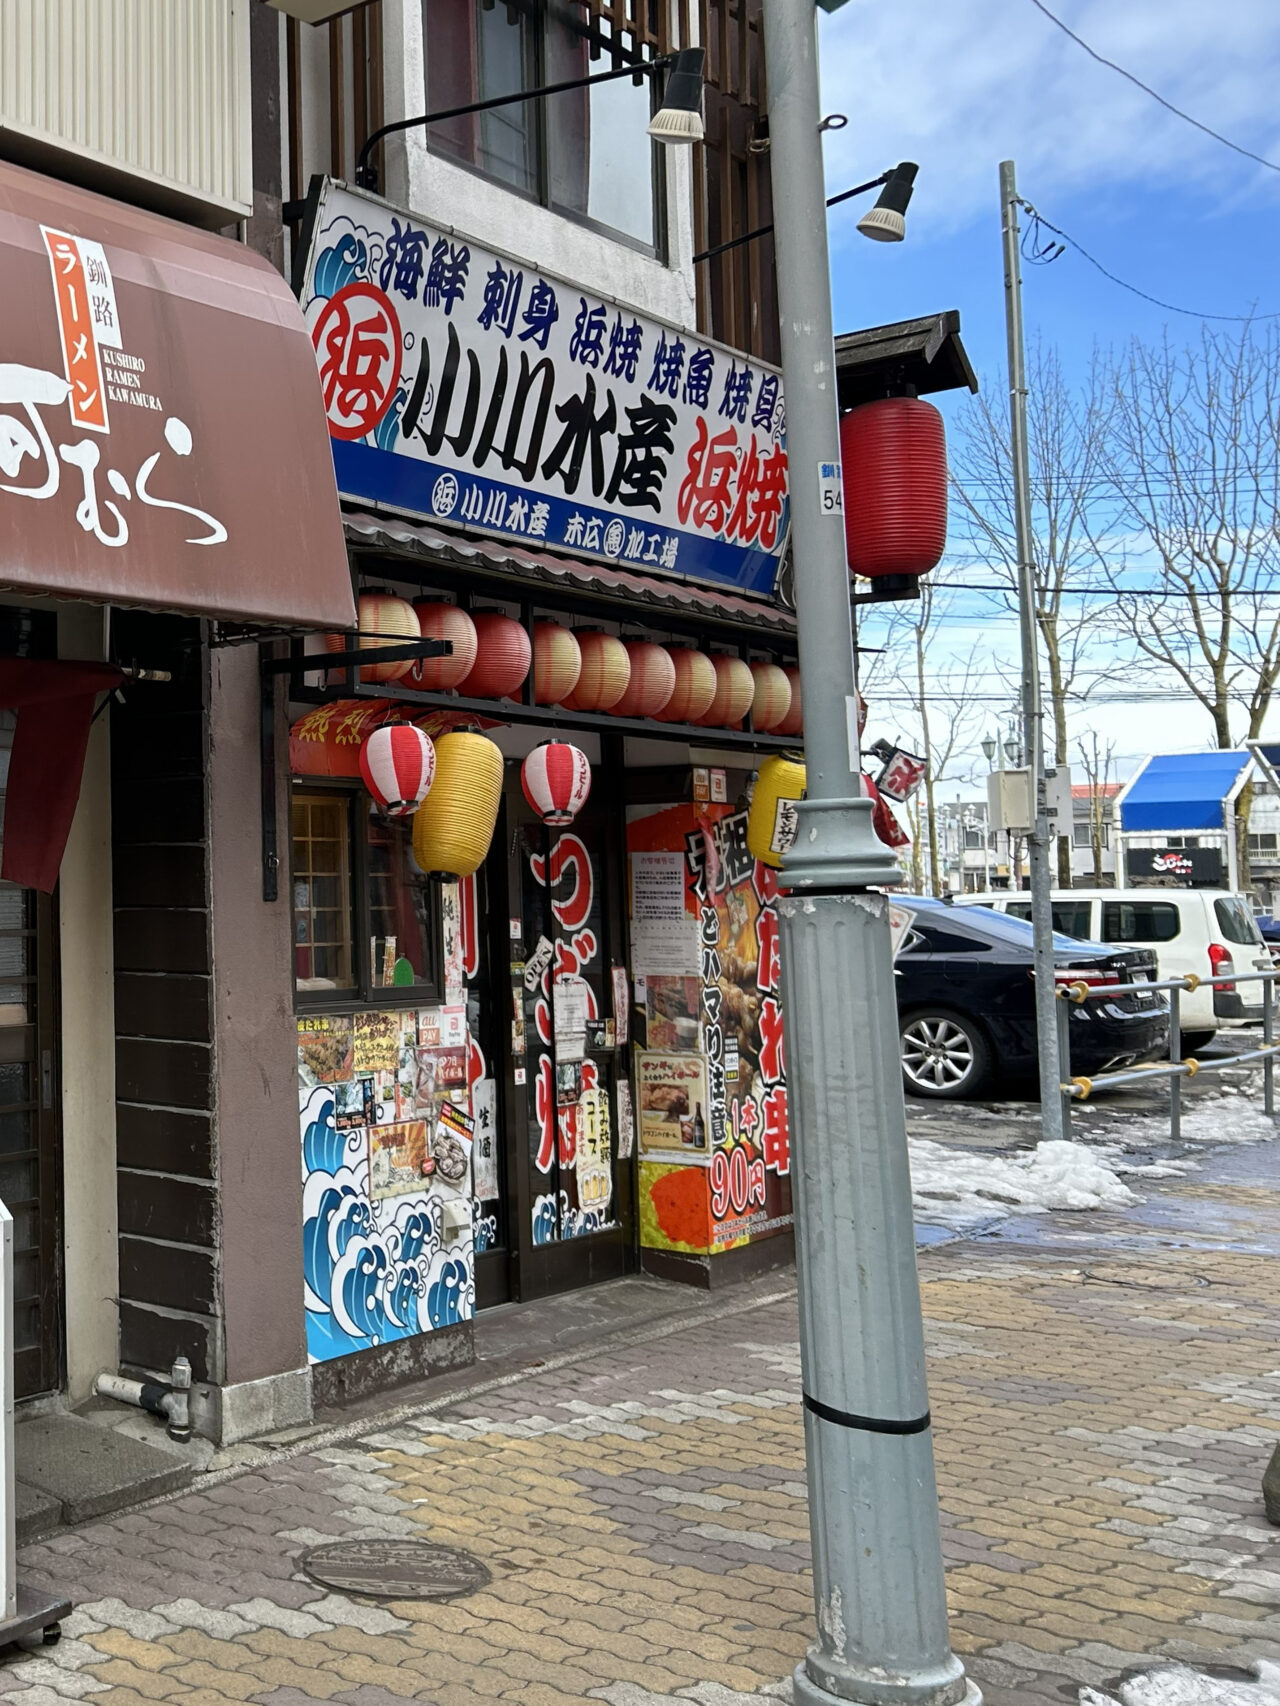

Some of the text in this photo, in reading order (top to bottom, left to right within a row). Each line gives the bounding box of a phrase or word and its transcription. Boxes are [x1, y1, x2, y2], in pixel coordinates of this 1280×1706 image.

[86, 254, 114, 329] 釧路
[378, 216, 471, 316] 海鮮
[477, 261, 559, 350] 刺身
[570, 297, 643, 384] 浜焼
[55, 243, 98, 413] ラーメン
[103, 349, 146, 372] KUSHIRO
[105, 366, 141, 389] RAMEN
[108, 385, 163, 411] KAWAMURA
[313, 290, 679, 514] 浜 小川水産
[677, 415, 789, 550] 浜焼
[460, 483, 551, 537] 小川水産
[779, 801, 797, 852] レモンサワー
[525, 946, 552, 985] OPEN
[423, 1028, 437, 1041] PAY
[752, 858, 789, 1176] たれ串
[586, 1101, 597, 1155] コース
[598, 1089, 611, 1164] 飲み放題
[731, 1095, 758, 1140] 1本
[710, 1146, 767, 1219] 90円
